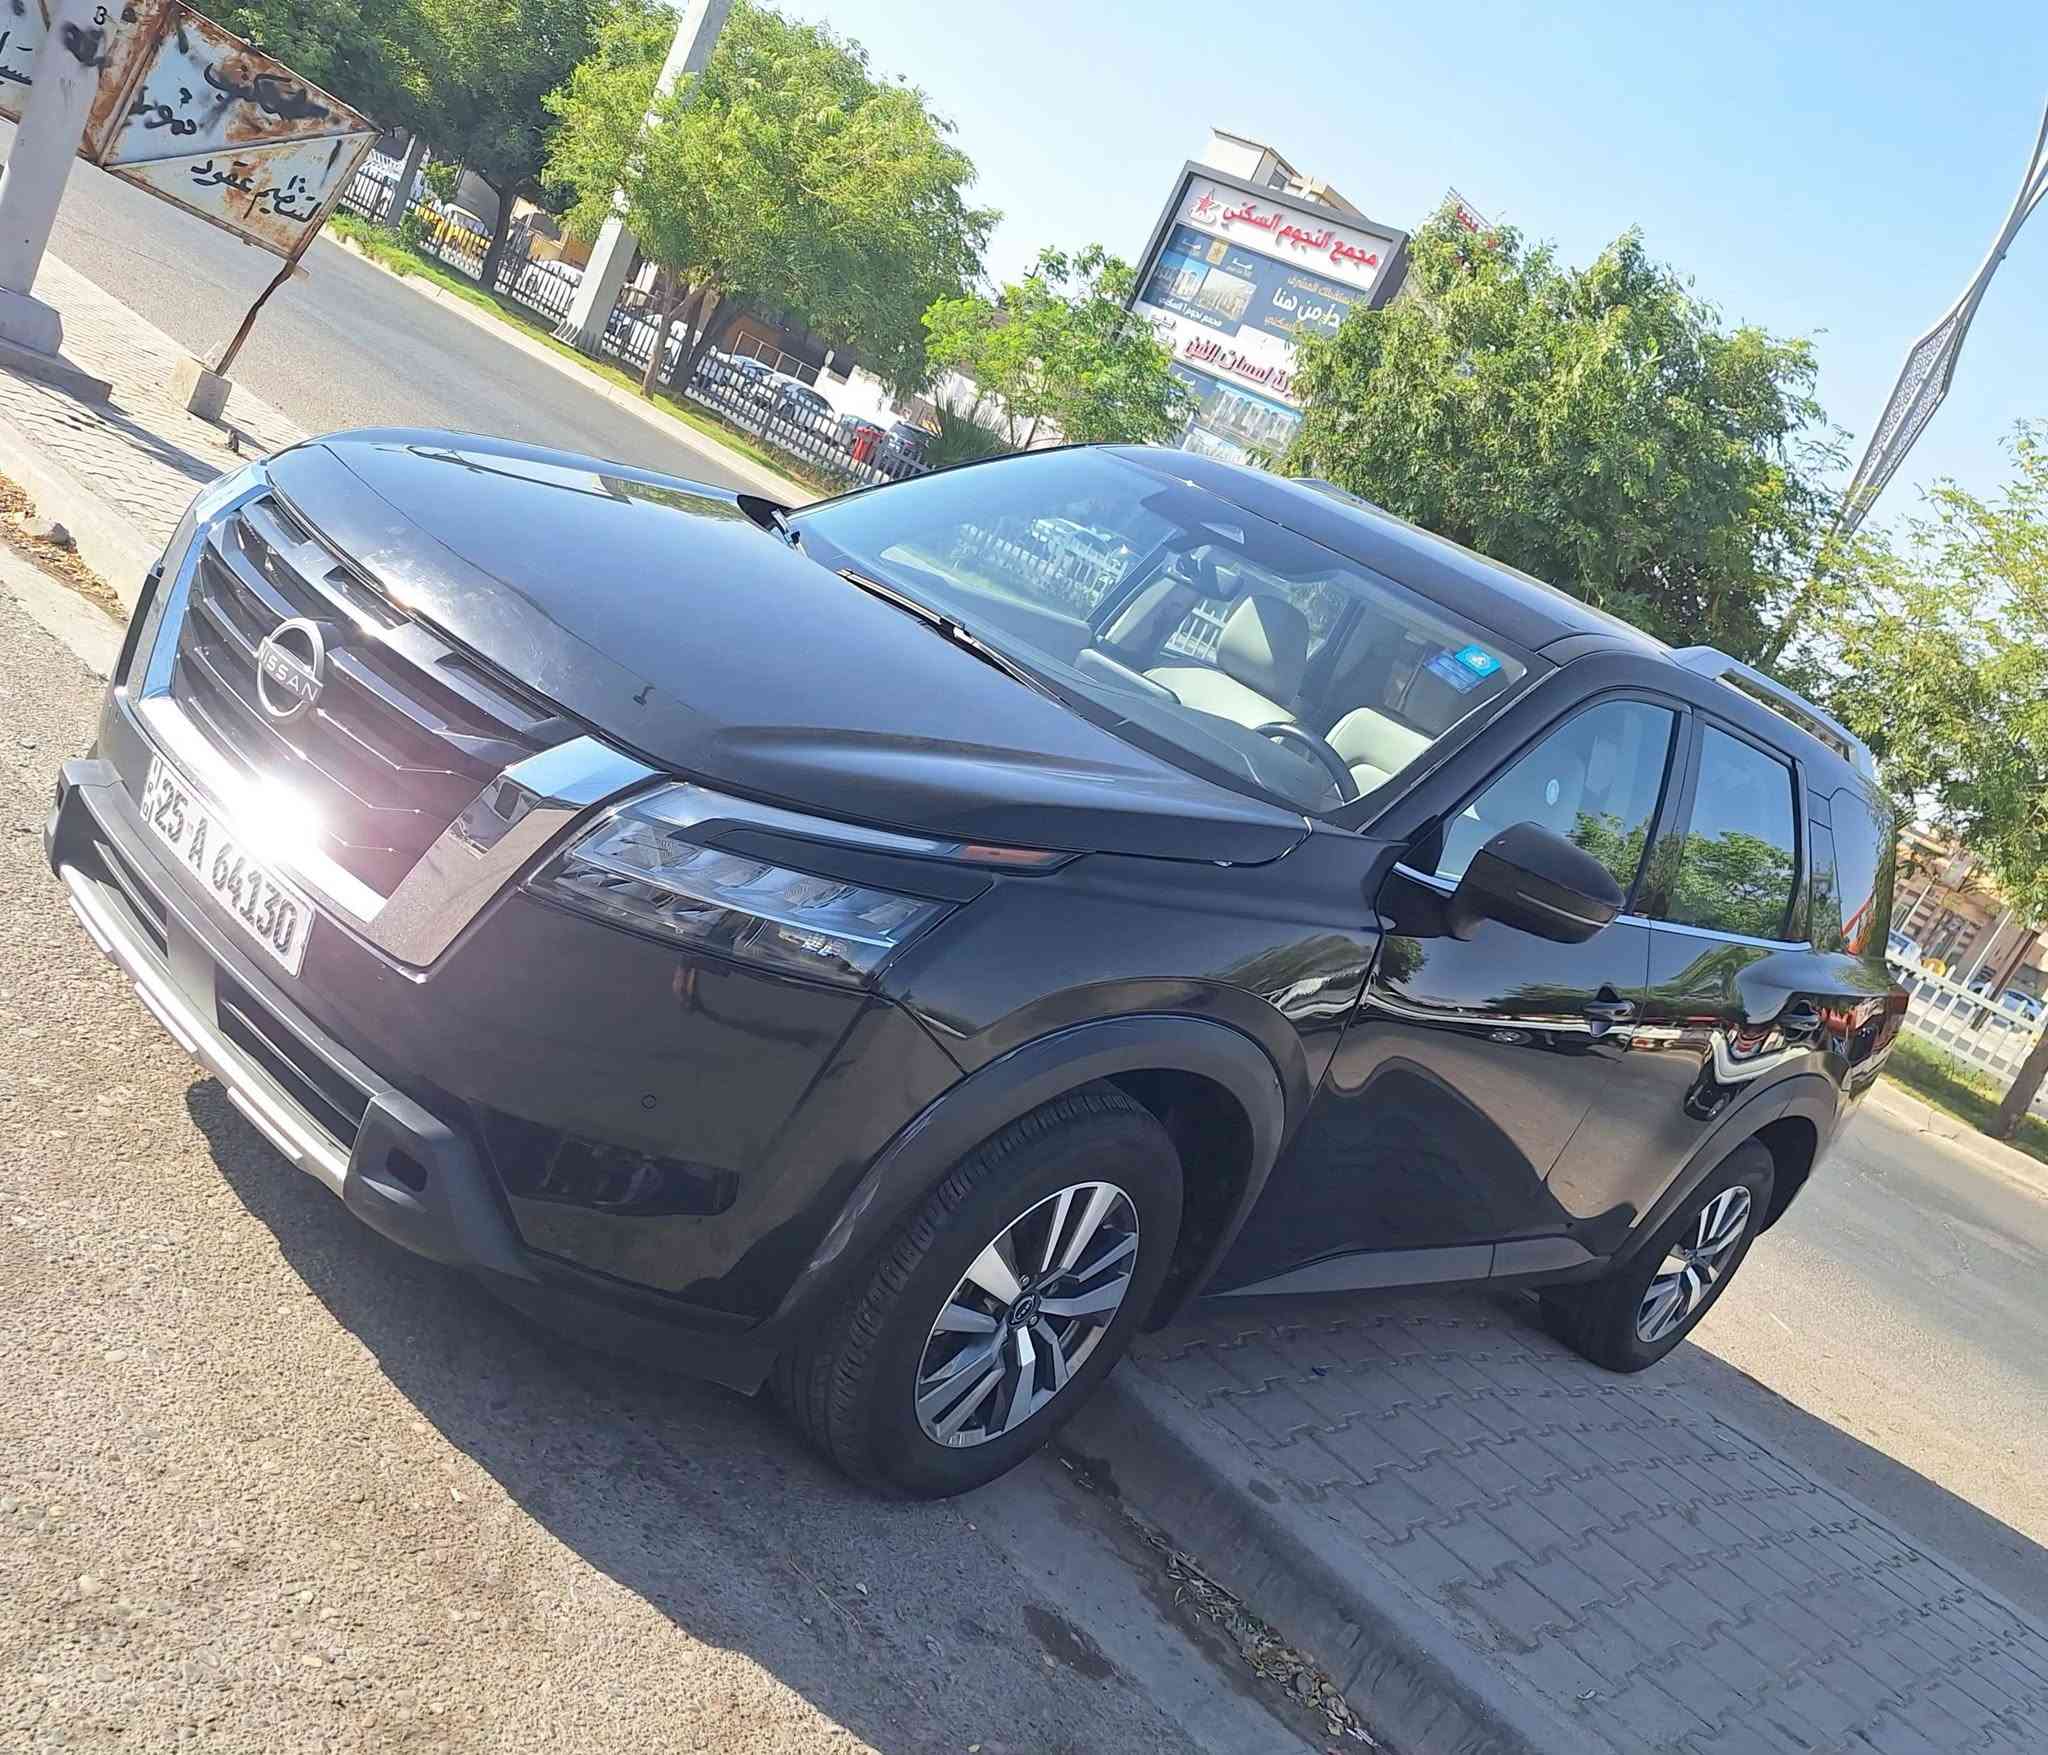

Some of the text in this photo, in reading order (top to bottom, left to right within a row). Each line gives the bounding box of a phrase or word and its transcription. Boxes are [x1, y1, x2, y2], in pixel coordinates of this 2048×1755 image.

[1221, 201, 1378, 268] مجمع النجوم السكني
[1271, 286, 1298, 313] هنا
[1296, 299, 1322, 321] من
[259, 639, 319, 702] NISSAN
[154, 778, 298, 954] 25 A 64130
